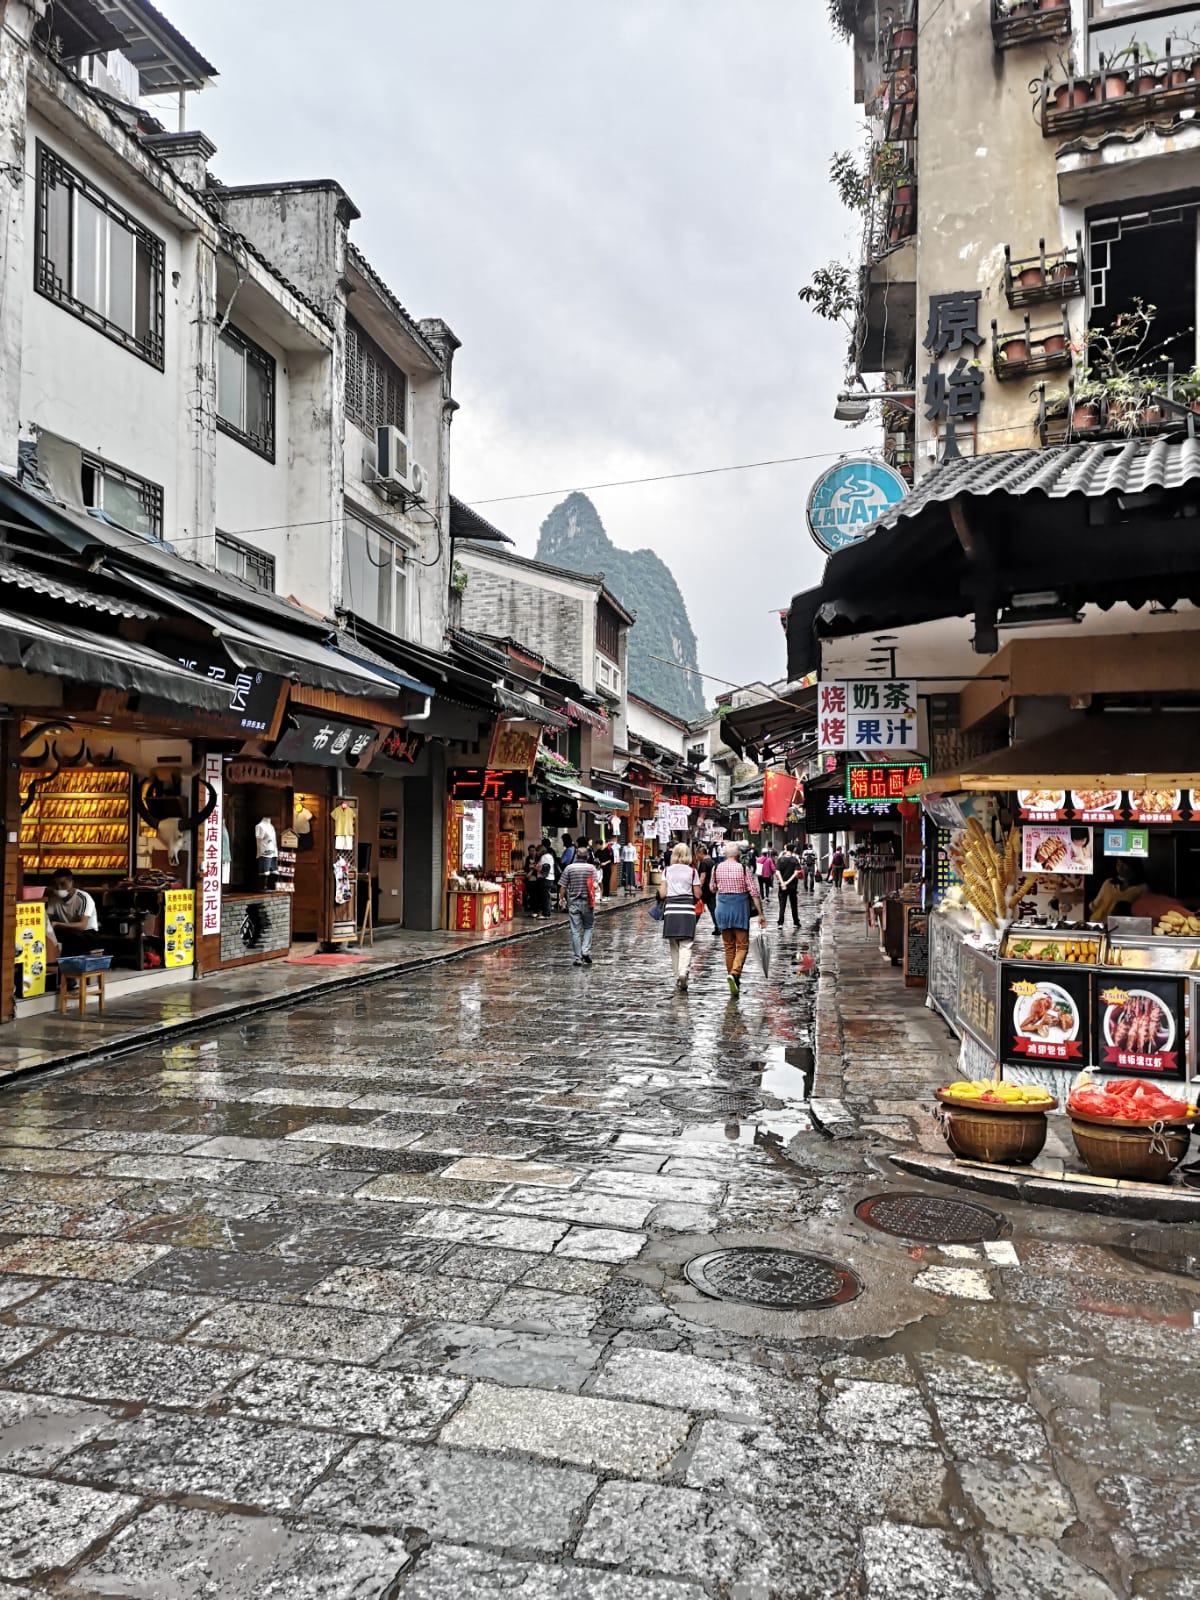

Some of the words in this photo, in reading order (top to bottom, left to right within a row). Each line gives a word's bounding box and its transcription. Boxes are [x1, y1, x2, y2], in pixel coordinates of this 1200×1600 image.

[821, 686, 846, 746] 烧烤
[853, 683, 910, 710] 奶茶
[856, 719, 913, 745] 果汁
[203, 757, 221, 930] 工厂销店全场29元起
